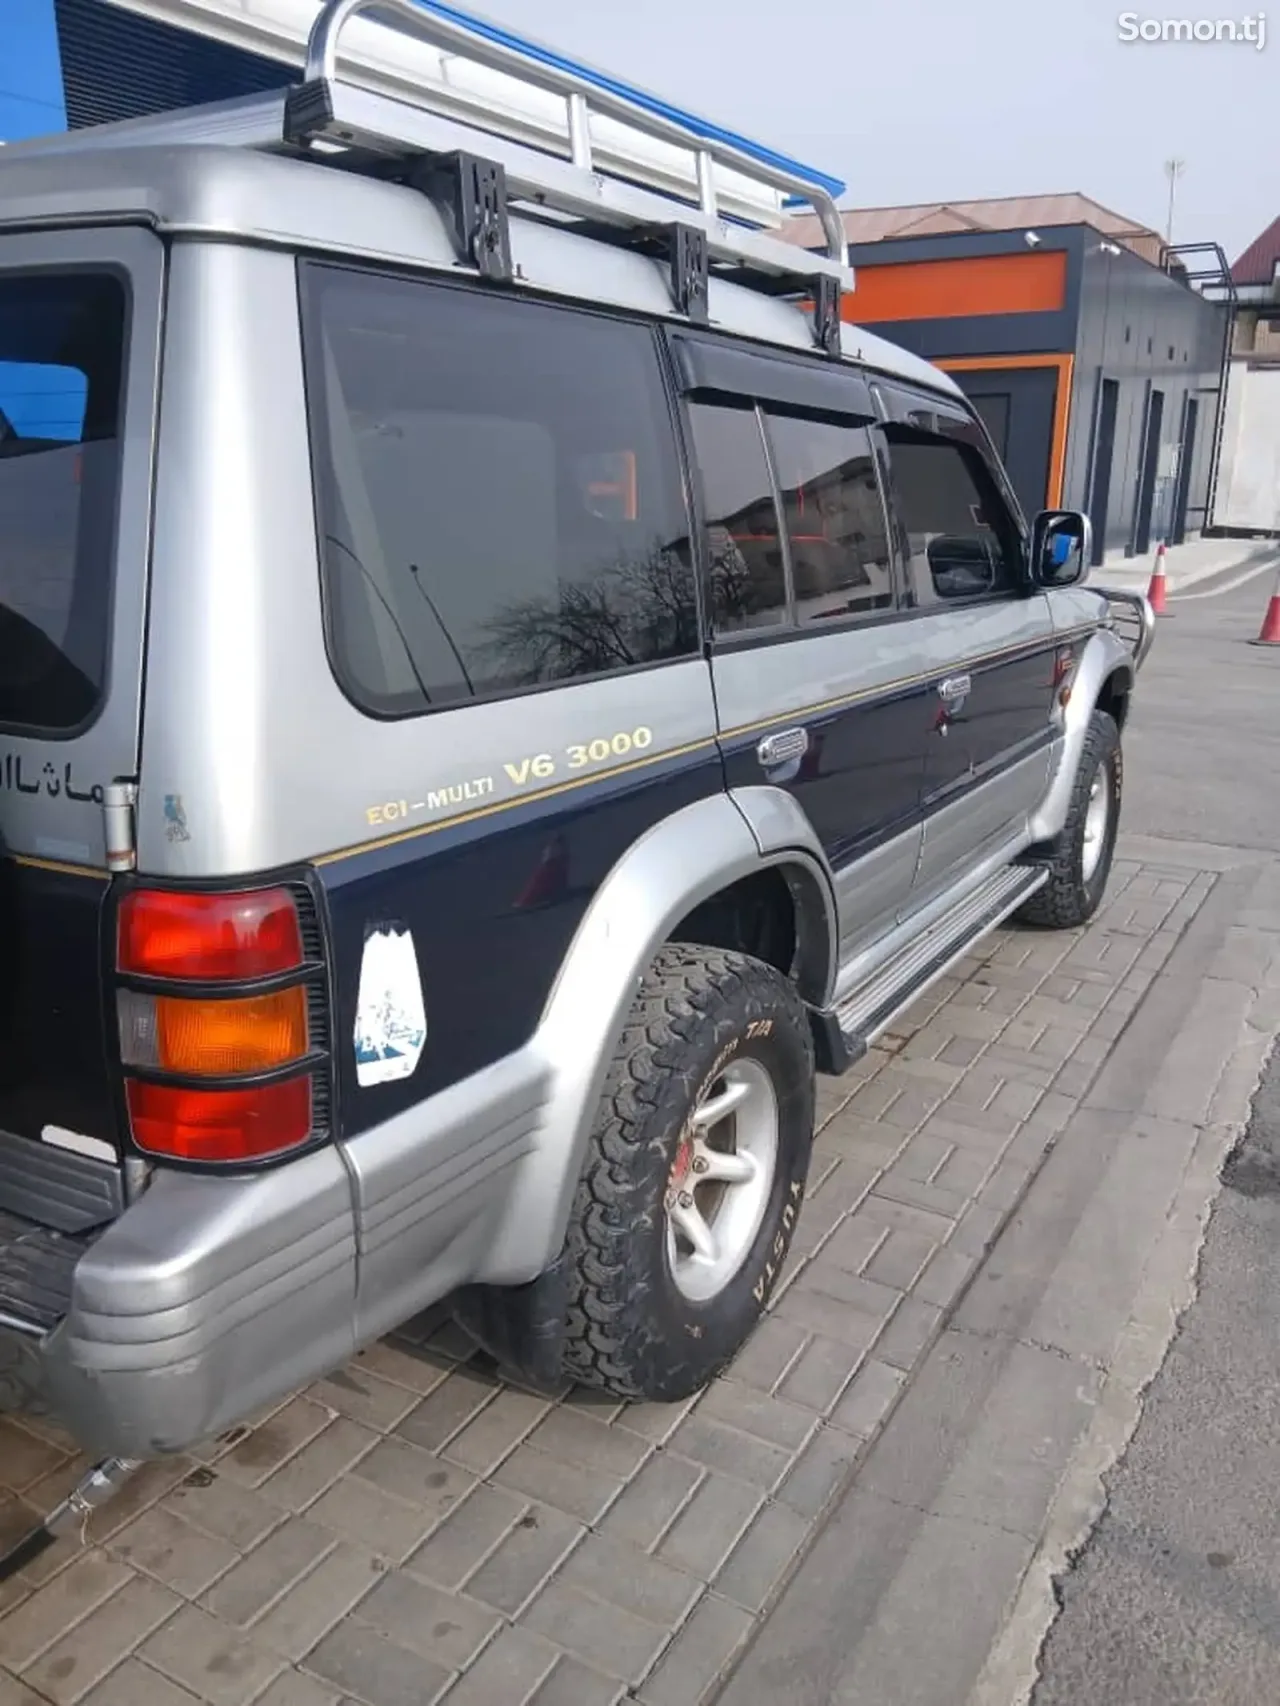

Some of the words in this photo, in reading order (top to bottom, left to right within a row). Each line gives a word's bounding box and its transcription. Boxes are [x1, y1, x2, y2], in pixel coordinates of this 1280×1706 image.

[366, 776, 494, 825] ECI-MULTI
[503, 753, 555, 785] V6
[566, 726, 652, 768] 3000
